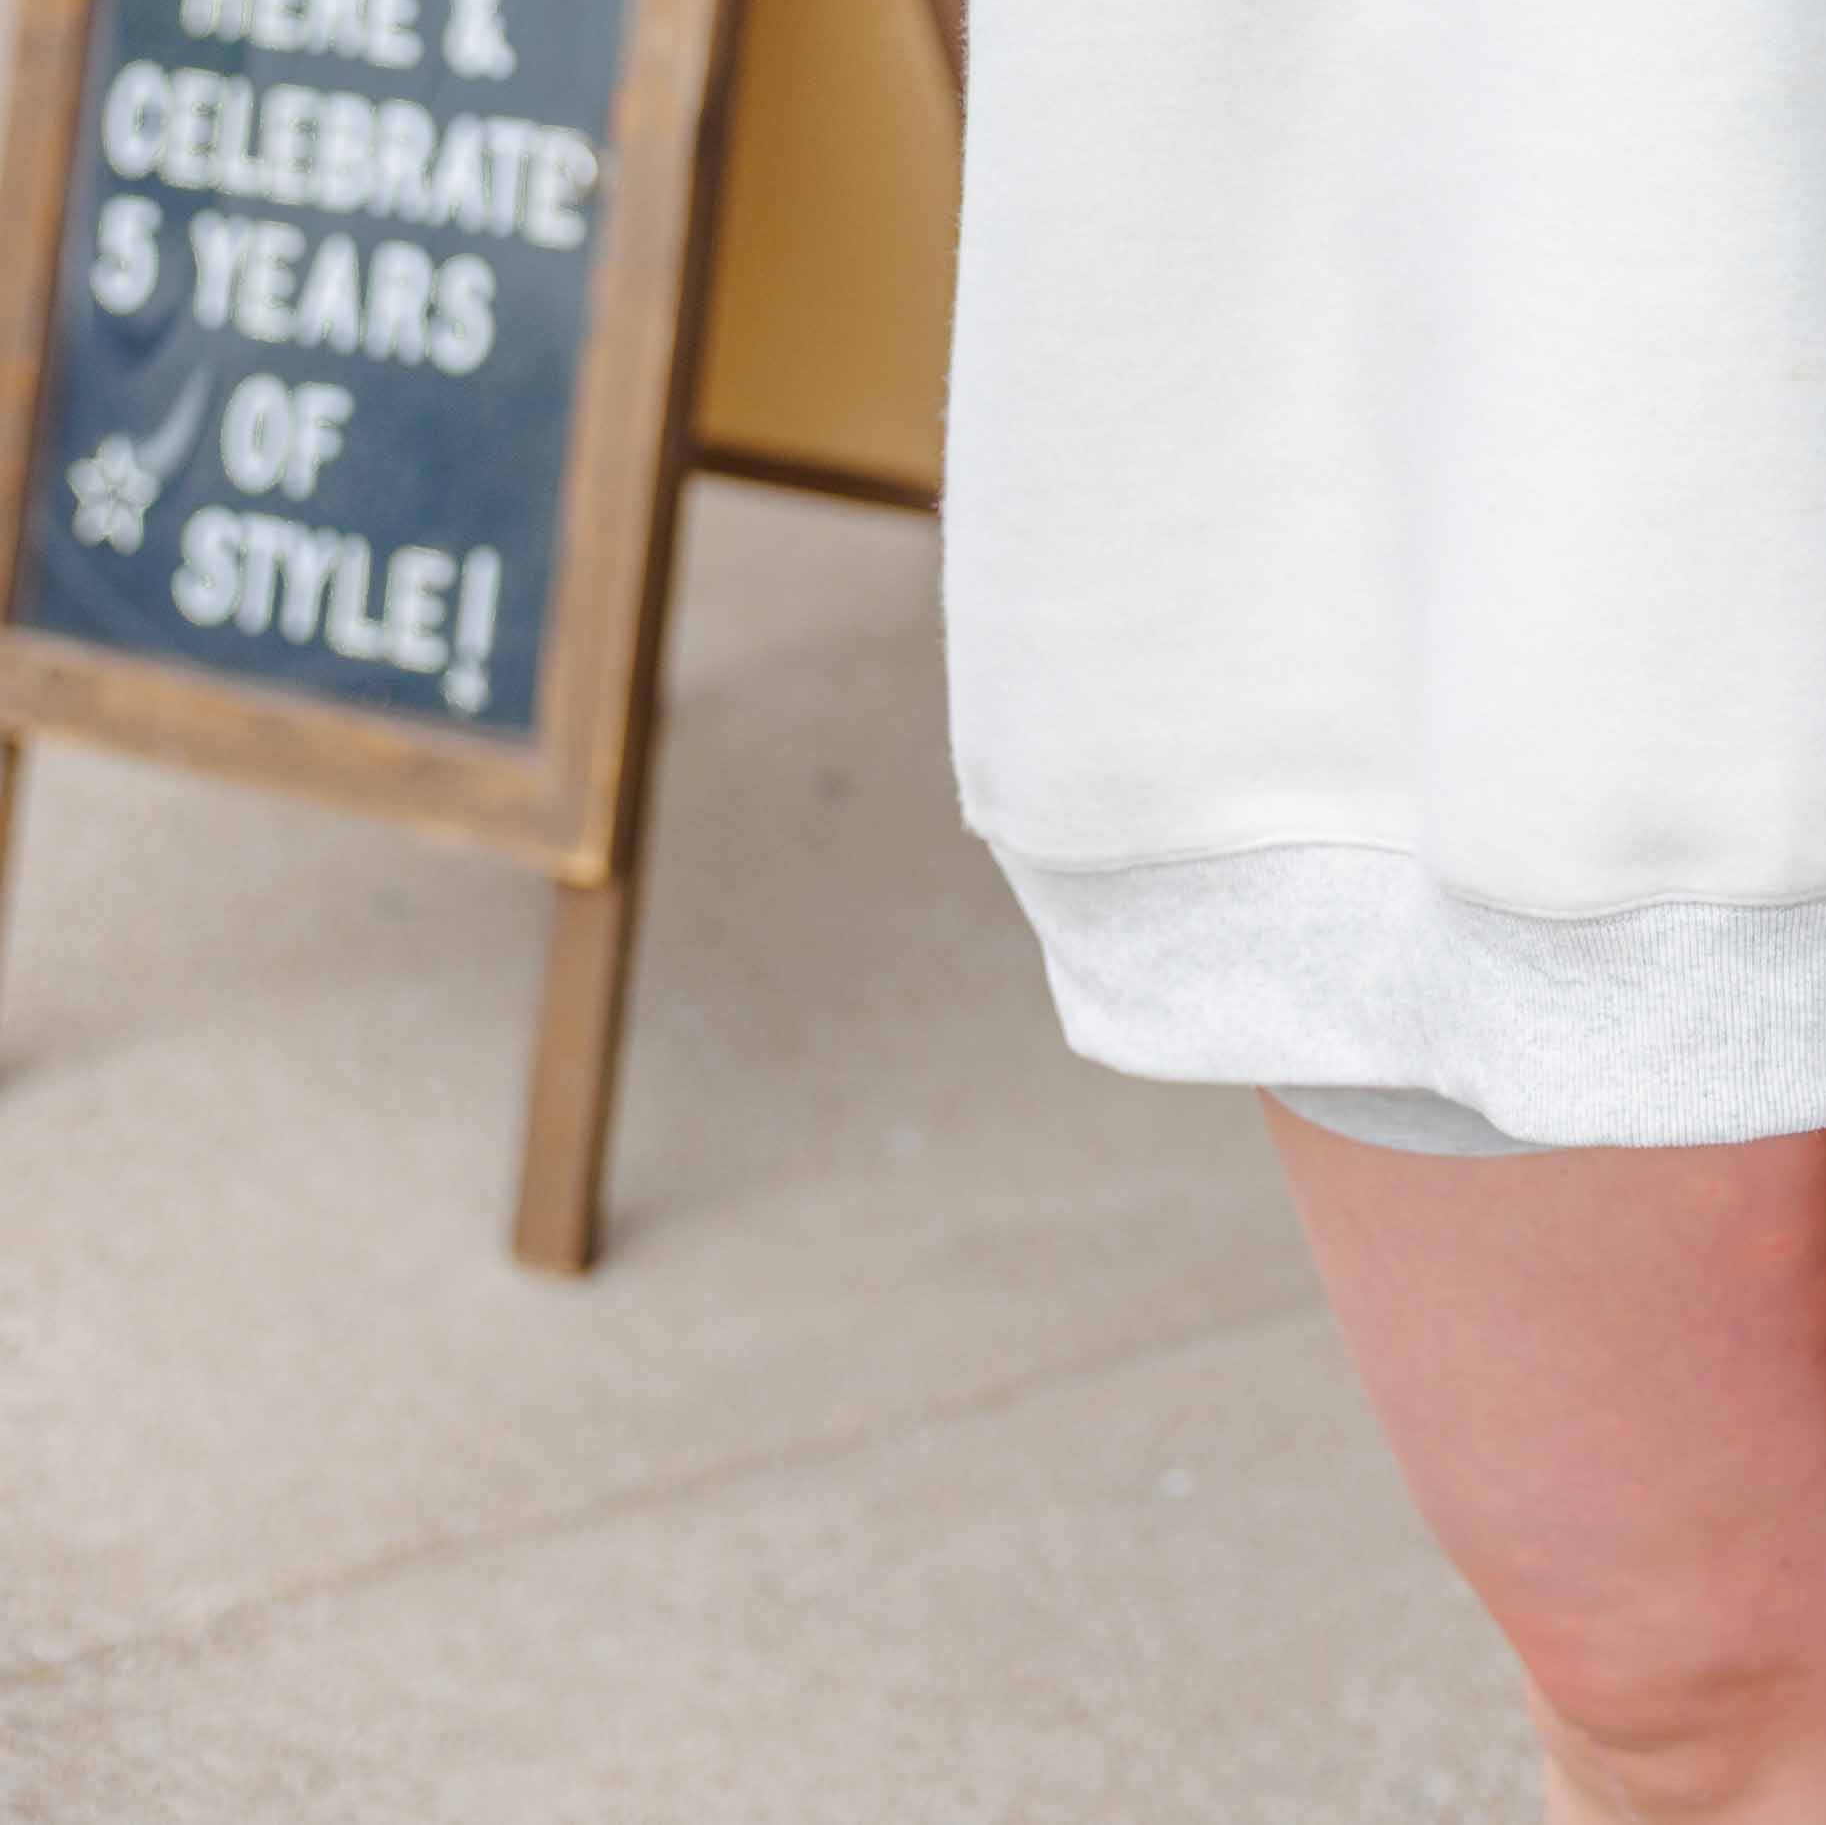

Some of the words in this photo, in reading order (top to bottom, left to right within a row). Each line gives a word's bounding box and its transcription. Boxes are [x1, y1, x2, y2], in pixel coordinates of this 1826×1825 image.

[103, 60, 597, 249] CELEBRATE
[90, 194, 163, 314] 5
[190, 209, 496, 376] YEARS
[220, 373, 355, 501] OF
[171, 505, 500, 715] STYLE!
